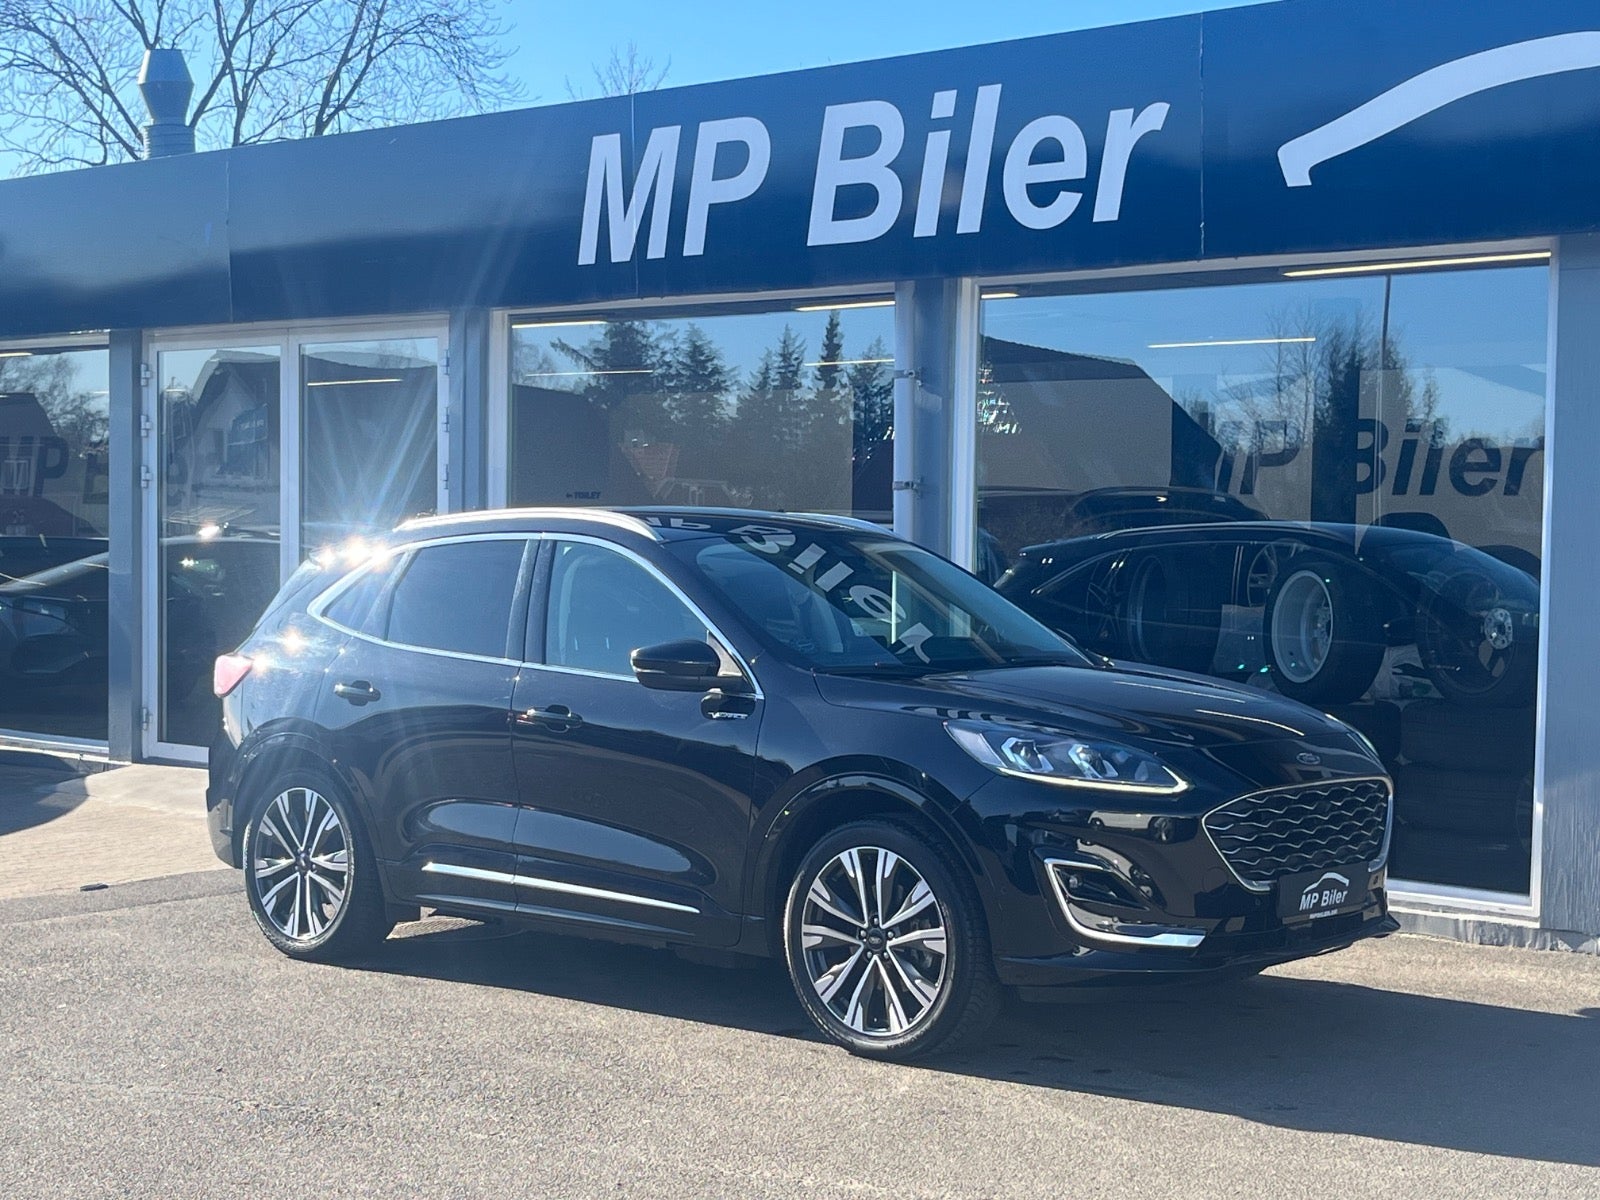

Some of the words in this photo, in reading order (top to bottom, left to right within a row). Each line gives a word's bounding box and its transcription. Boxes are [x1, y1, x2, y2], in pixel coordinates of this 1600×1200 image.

[577, 117, 771, 266] MP
[807, 84, 1170, 247] Biler
[1299, 892, 1319, 911] MP
[1321, 888, 1348, 907] Biler
